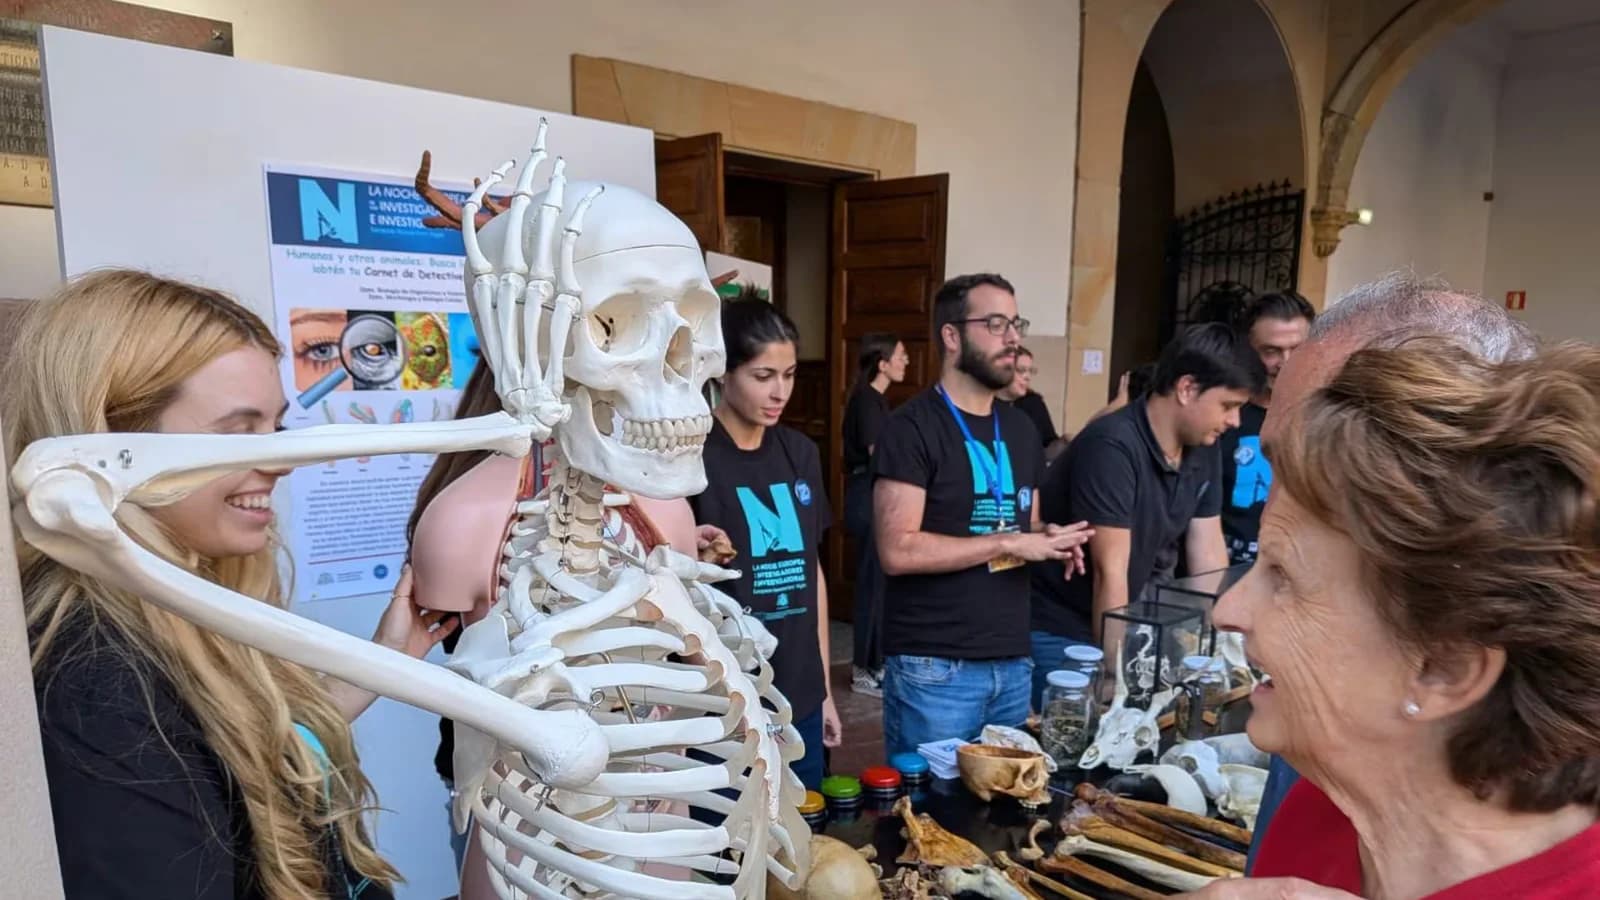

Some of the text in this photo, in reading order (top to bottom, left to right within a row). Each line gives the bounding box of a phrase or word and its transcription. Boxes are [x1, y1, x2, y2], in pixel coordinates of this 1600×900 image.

[368, 185, 381, 196] LA
[298, 178, 358, 244] N
[286, 248, 333, 261] Humanos
[337, 254, 344, 264] y
[348, 254, 375, 264] otros
[350, 266, 360, 275] tu
[364, 266, 398, 279] Carnet
[402, 267, 413, 279] de
[418, 269, 463, 281] Detective
[736, 483, 804, 557] N
